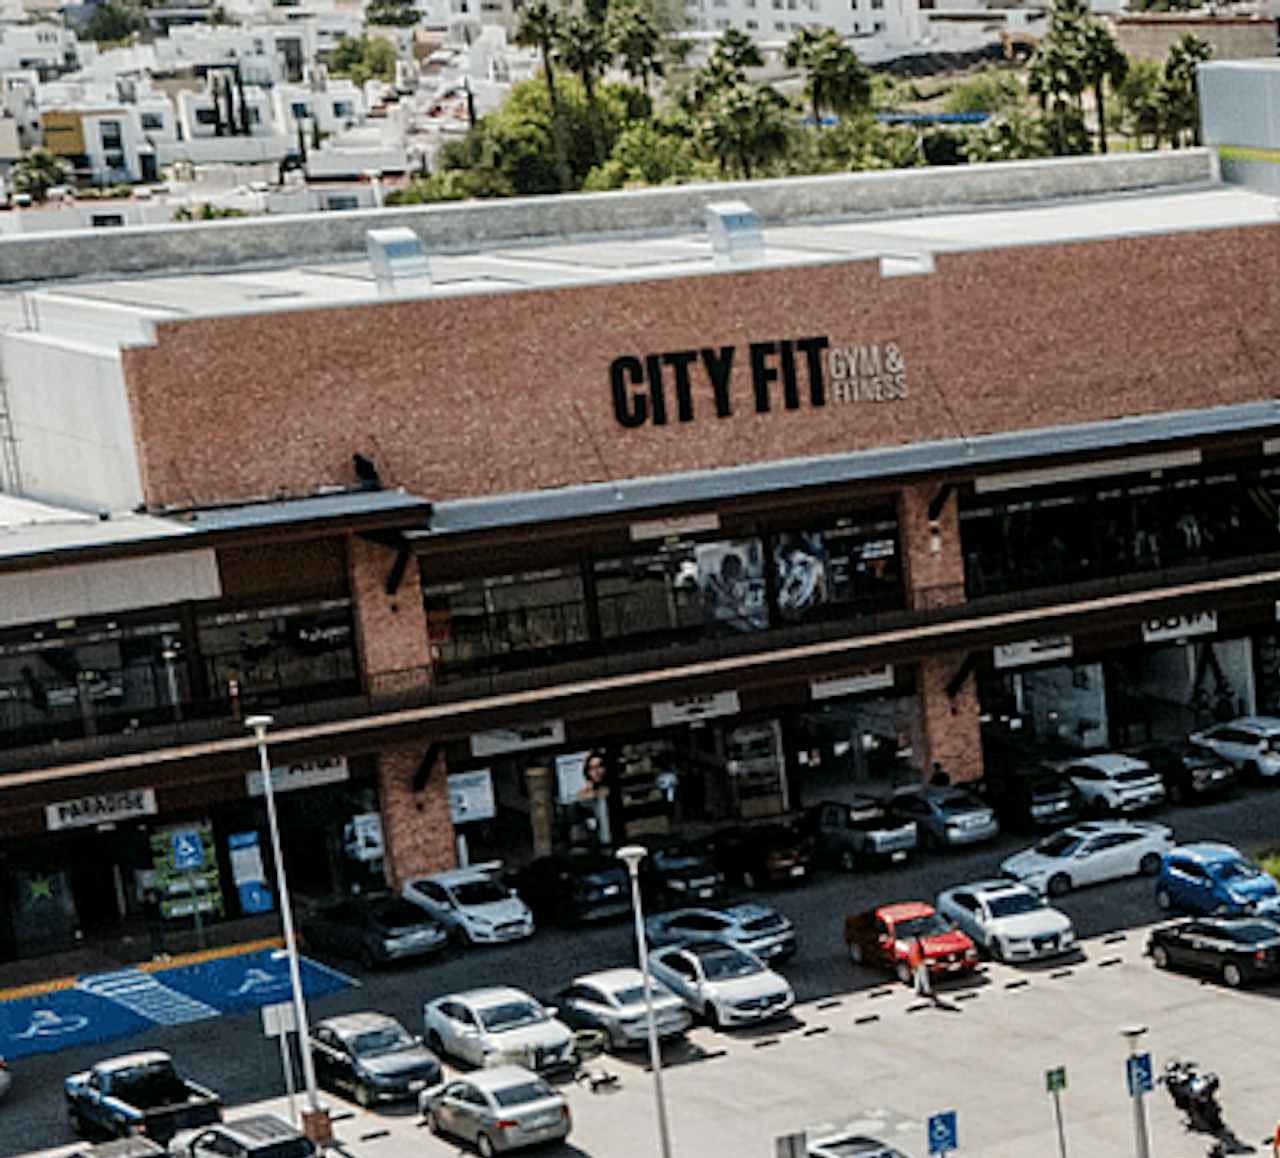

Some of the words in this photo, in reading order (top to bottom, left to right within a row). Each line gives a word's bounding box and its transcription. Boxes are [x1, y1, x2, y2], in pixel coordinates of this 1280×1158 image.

[829, 346, 881, 380] GYM
[885, 342, 904, 372] &
[609, 345, 736, 428] CITY
[749, 336, 829, 414] FIT
[832, 372, 908, 404] FITNESS
